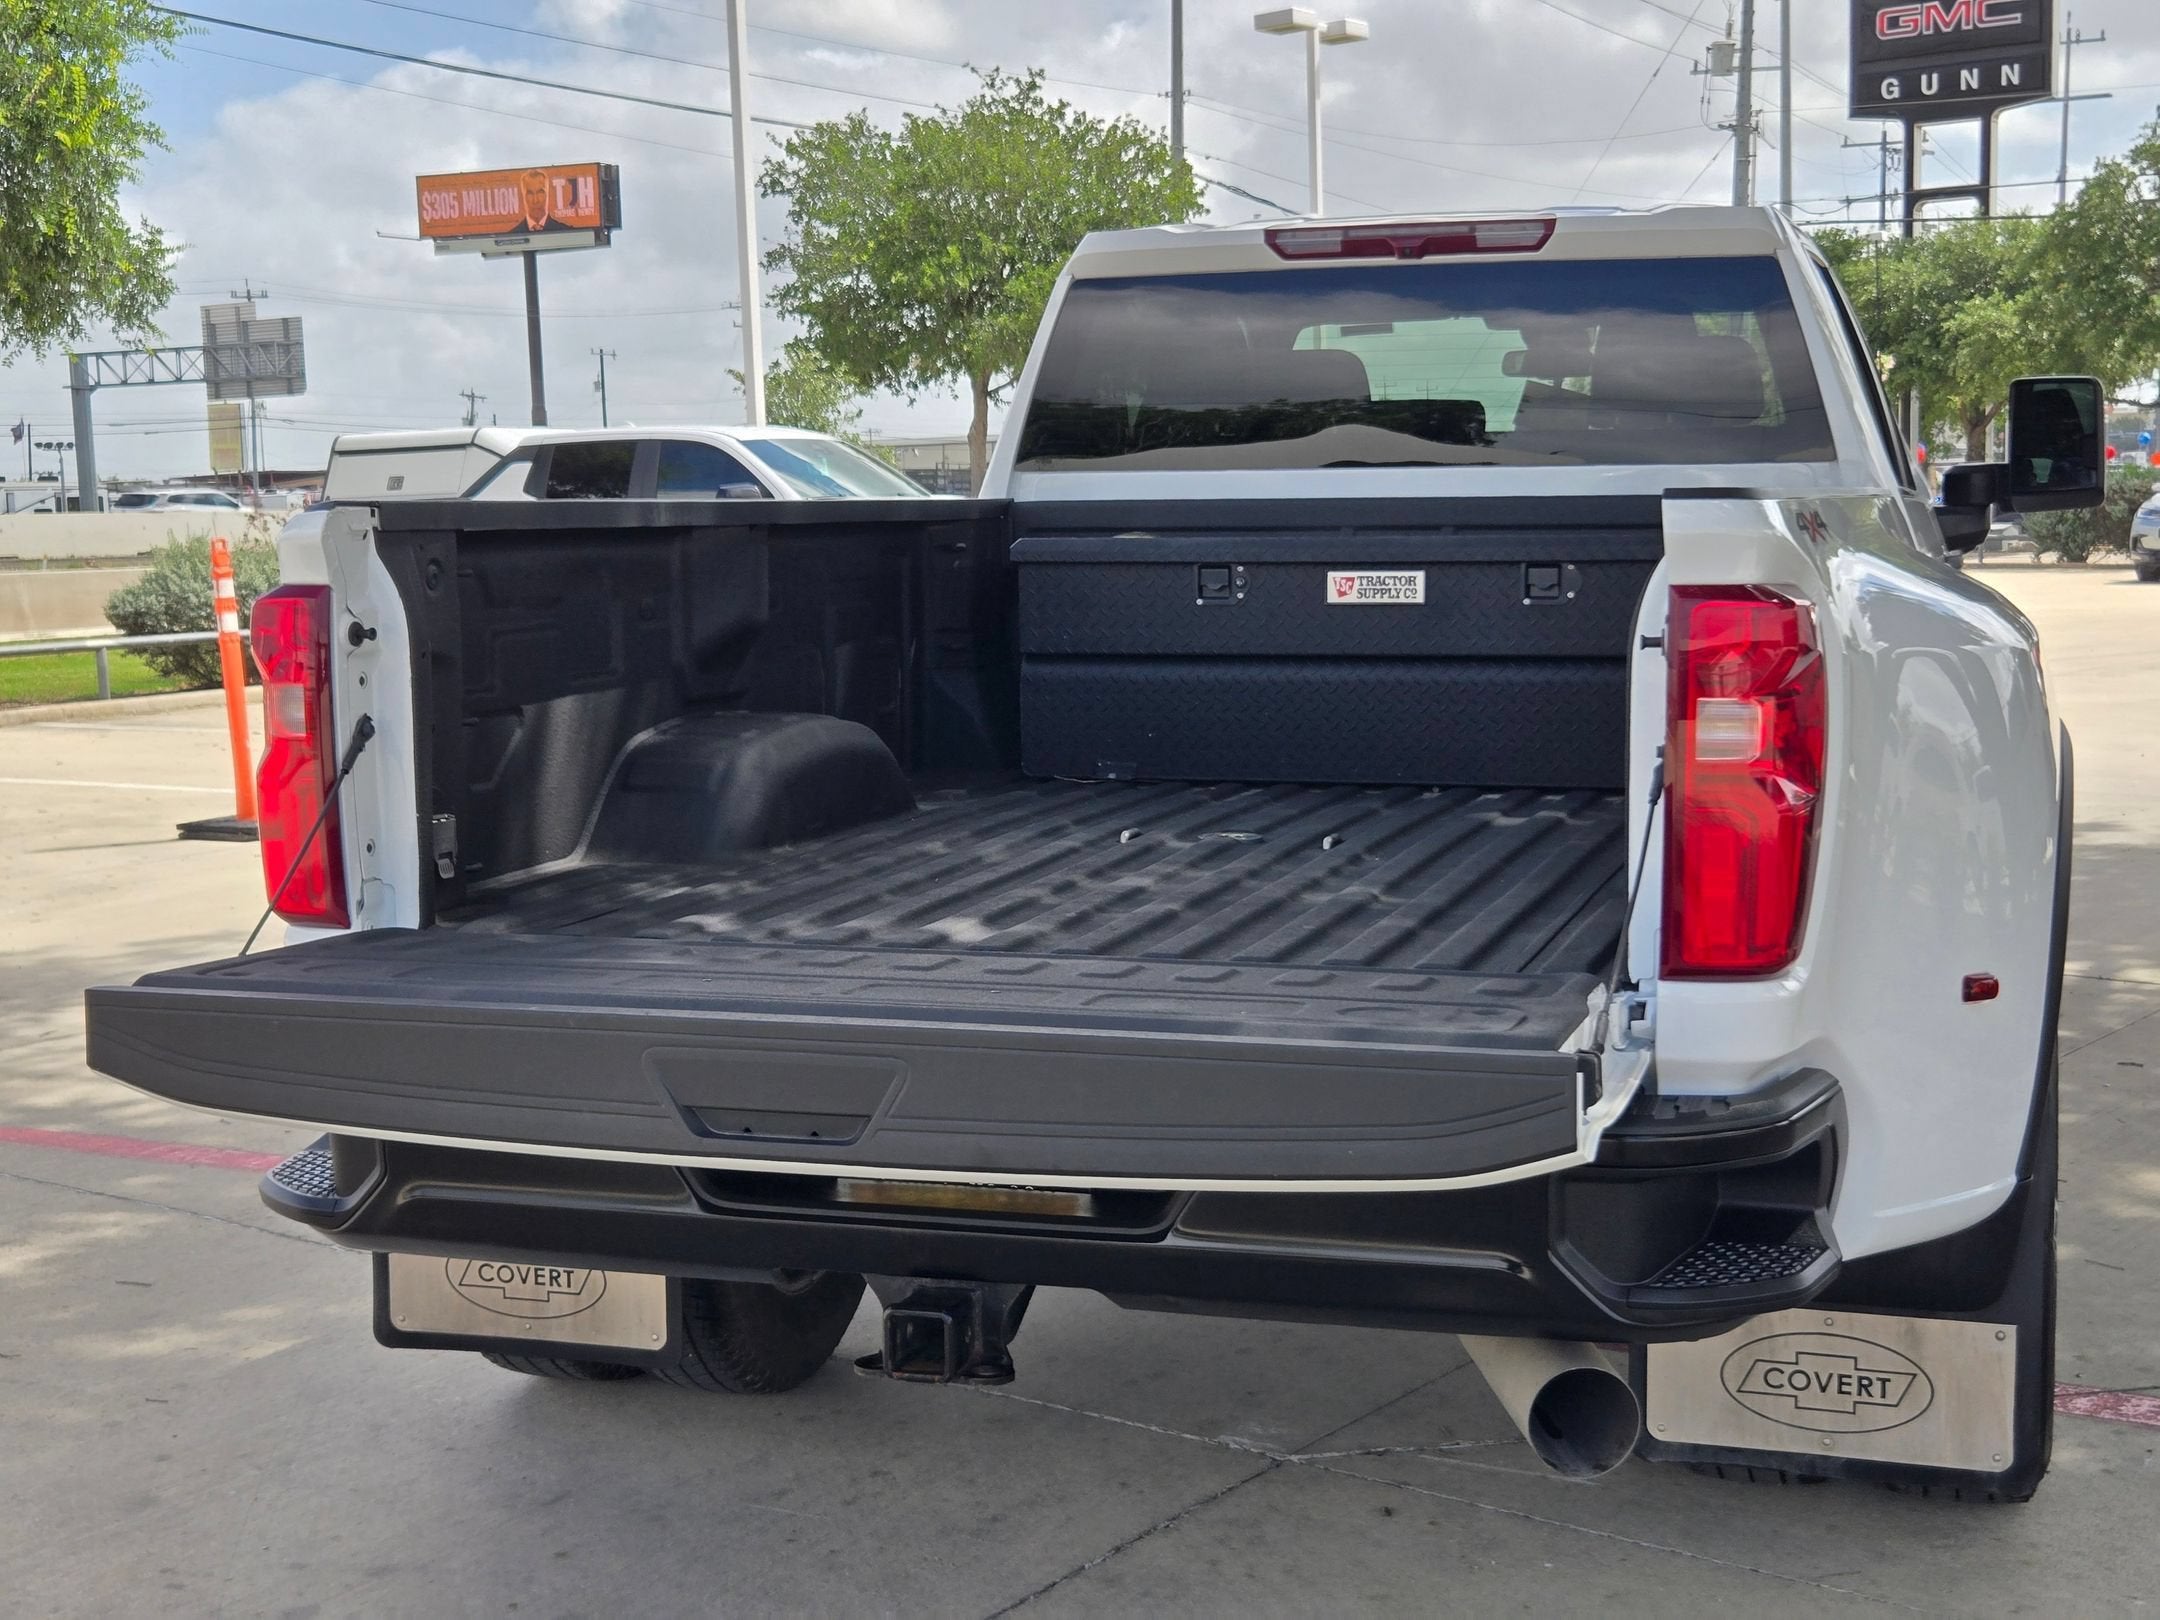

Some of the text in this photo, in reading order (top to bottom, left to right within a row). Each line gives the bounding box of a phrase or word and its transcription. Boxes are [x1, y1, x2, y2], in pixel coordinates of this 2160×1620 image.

[1876, 0, 2022, 40] GMC
[1880, 63, 2020, 100] GUNN
[422, 187, 519, 223] $305 MILLION
[1332, 577, 1353, 595] TSC
[1356, 575, 1417, 587] TRACTOR
[1356, 587, 1402, 599] SUPPLY
[477, 1262, 575, 1289] COVERT
[1763, 1367, 1891, 1399] COVERT
